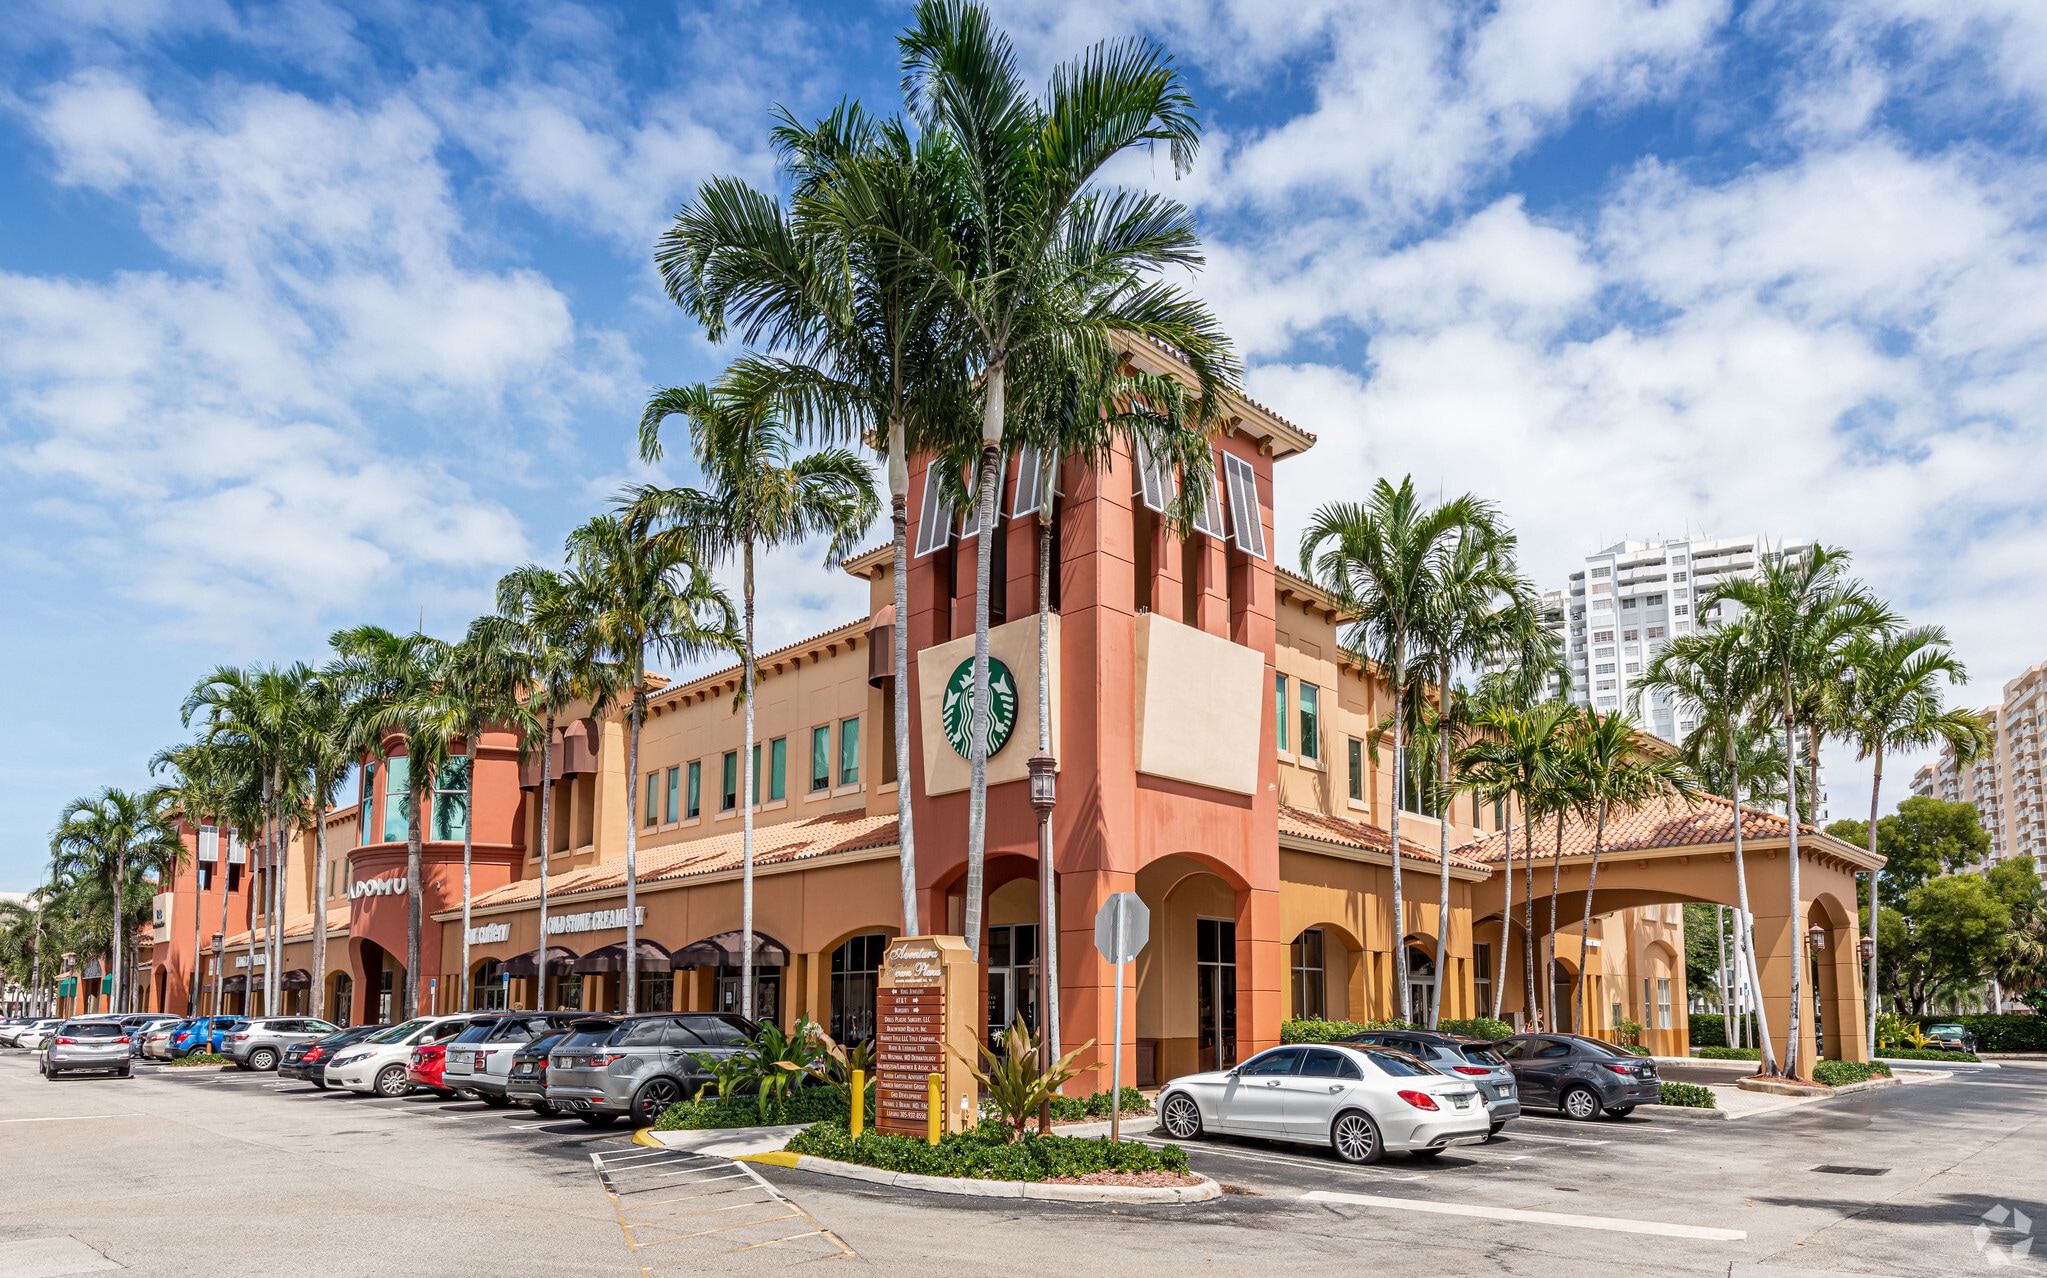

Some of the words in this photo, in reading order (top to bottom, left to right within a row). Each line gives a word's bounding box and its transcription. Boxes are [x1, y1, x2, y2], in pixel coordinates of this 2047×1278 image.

[347, 878, 407, 901] ADOMU
[547, 916, 565, 934] COLD
[566, 913, 591, 932] STONE
[592, 906, 646, 930] CREAMEY
[889, 943, 938, 960] Aventura
[887, 963, 912, 977] Town
[914, 962, 941, 977] Plaza
